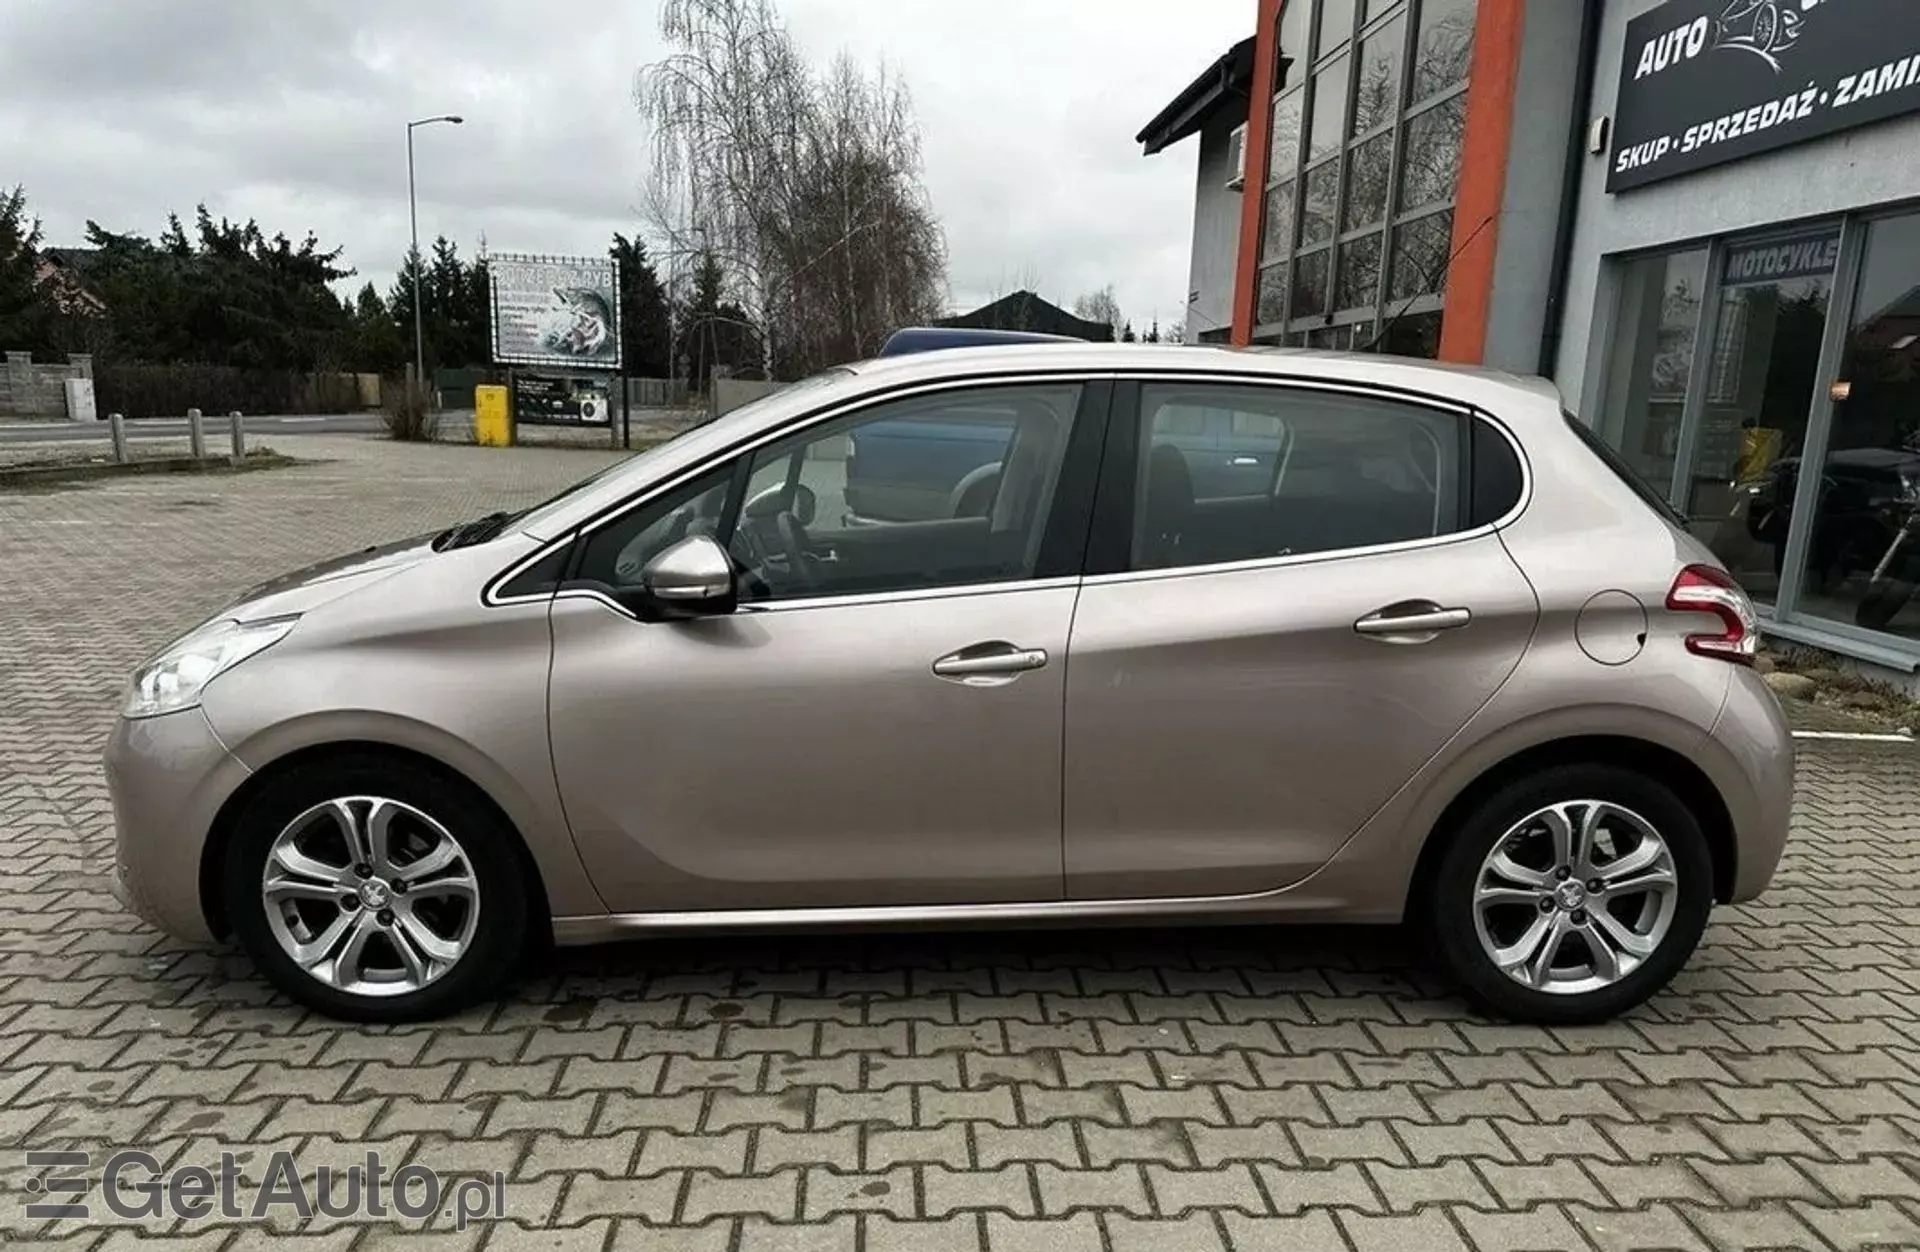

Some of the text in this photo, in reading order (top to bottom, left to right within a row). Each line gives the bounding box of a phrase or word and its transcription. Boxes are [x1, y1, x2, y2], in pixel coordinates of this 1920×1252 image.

[1634, 16, 1708, 80] AUTO
[1615, 54, 1920, 172] SKUP SPRZEDAŻ ZAMI
[1727, 238, 1839, 279] MOTOCYKLE
